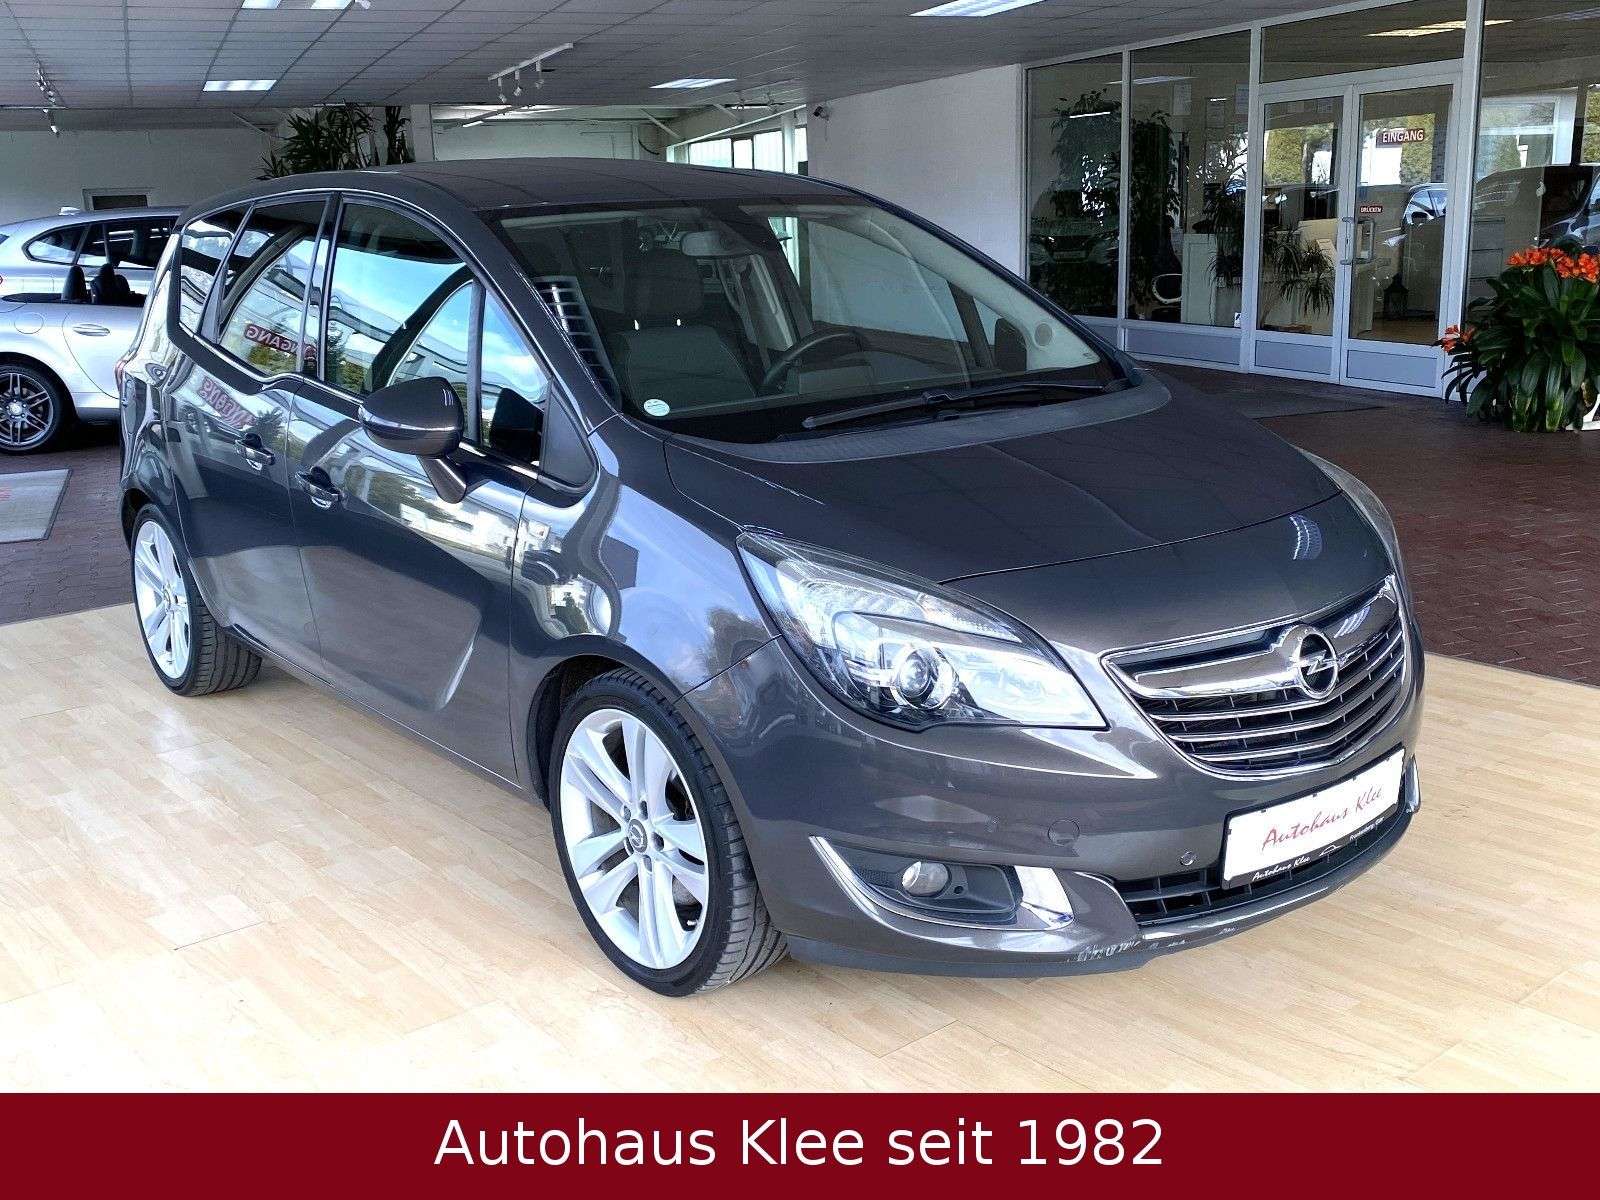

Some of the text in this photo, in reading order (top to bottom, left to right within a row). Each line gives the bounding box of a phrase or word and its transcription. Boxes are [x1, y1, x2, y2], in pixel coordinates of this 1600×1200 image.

[1382, 130, 1424, 143] EINGANG
[1261, 809, 1348, 852] Autohaus
[1355, 784, 1382, 812] Klee
[1252, 855, 1311, 881] Autohaus Klee
